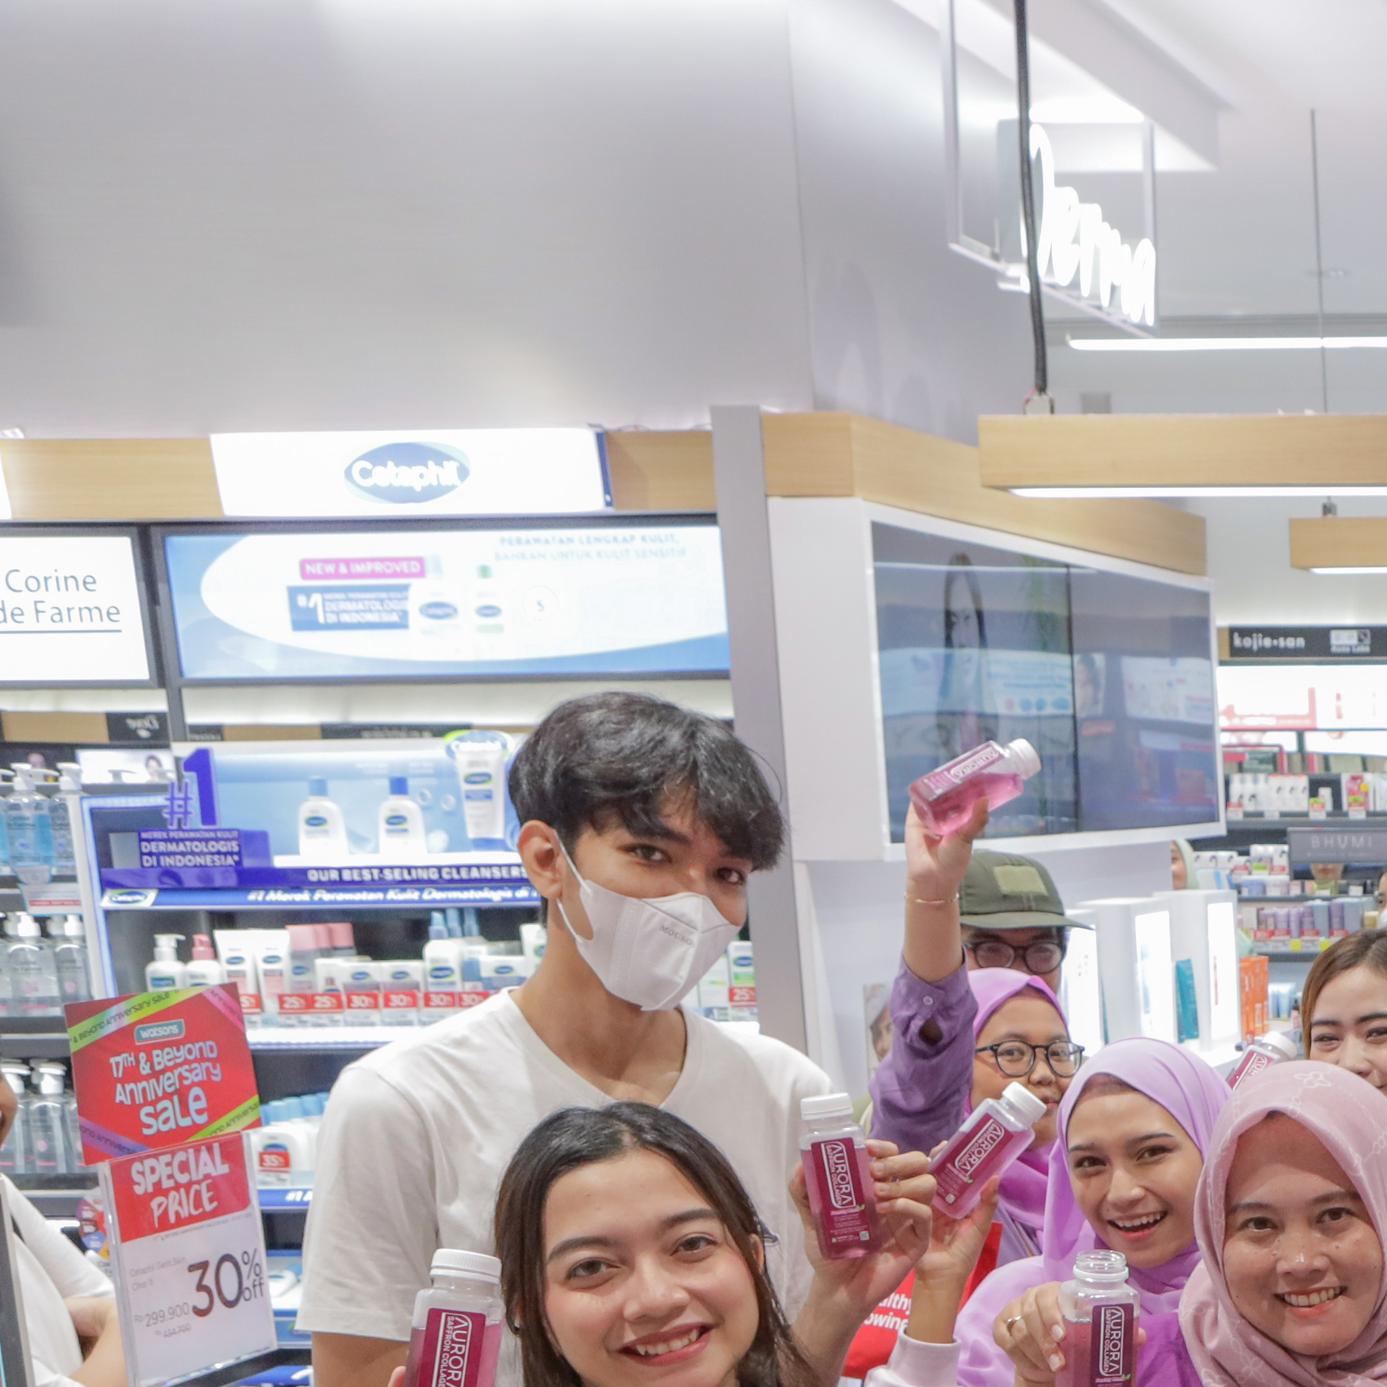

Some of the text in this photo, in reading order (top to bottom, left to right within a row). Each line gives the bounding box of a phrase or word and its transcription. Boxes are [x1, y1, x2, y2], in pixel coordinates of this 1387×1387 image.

[305, 561, 337, 575] NEW
[350, 560, 420, 575] IMPROVED
[5, 569, 97, 593] Corine
[34, 601, 121, 625] Farme
[166, 747, 218, 829] #1
[140, 840, 240, 854] DERMATOLOGIS
[142, 855, 158, 867] DI
[307, 869, 340, 881] OUR
[139, 1051, 152, 1076] &
[959, 1123, 1002, 1174] AURORA
[130, 1142, 230, 1196] SPECIAL
[828, 1142, 852, 1206] AURORA
[150, 1180, 219, 1229] PRICE
[243, 1276, 265, 1303] off
[1108, 1308, 1121, 1373] AURORA
